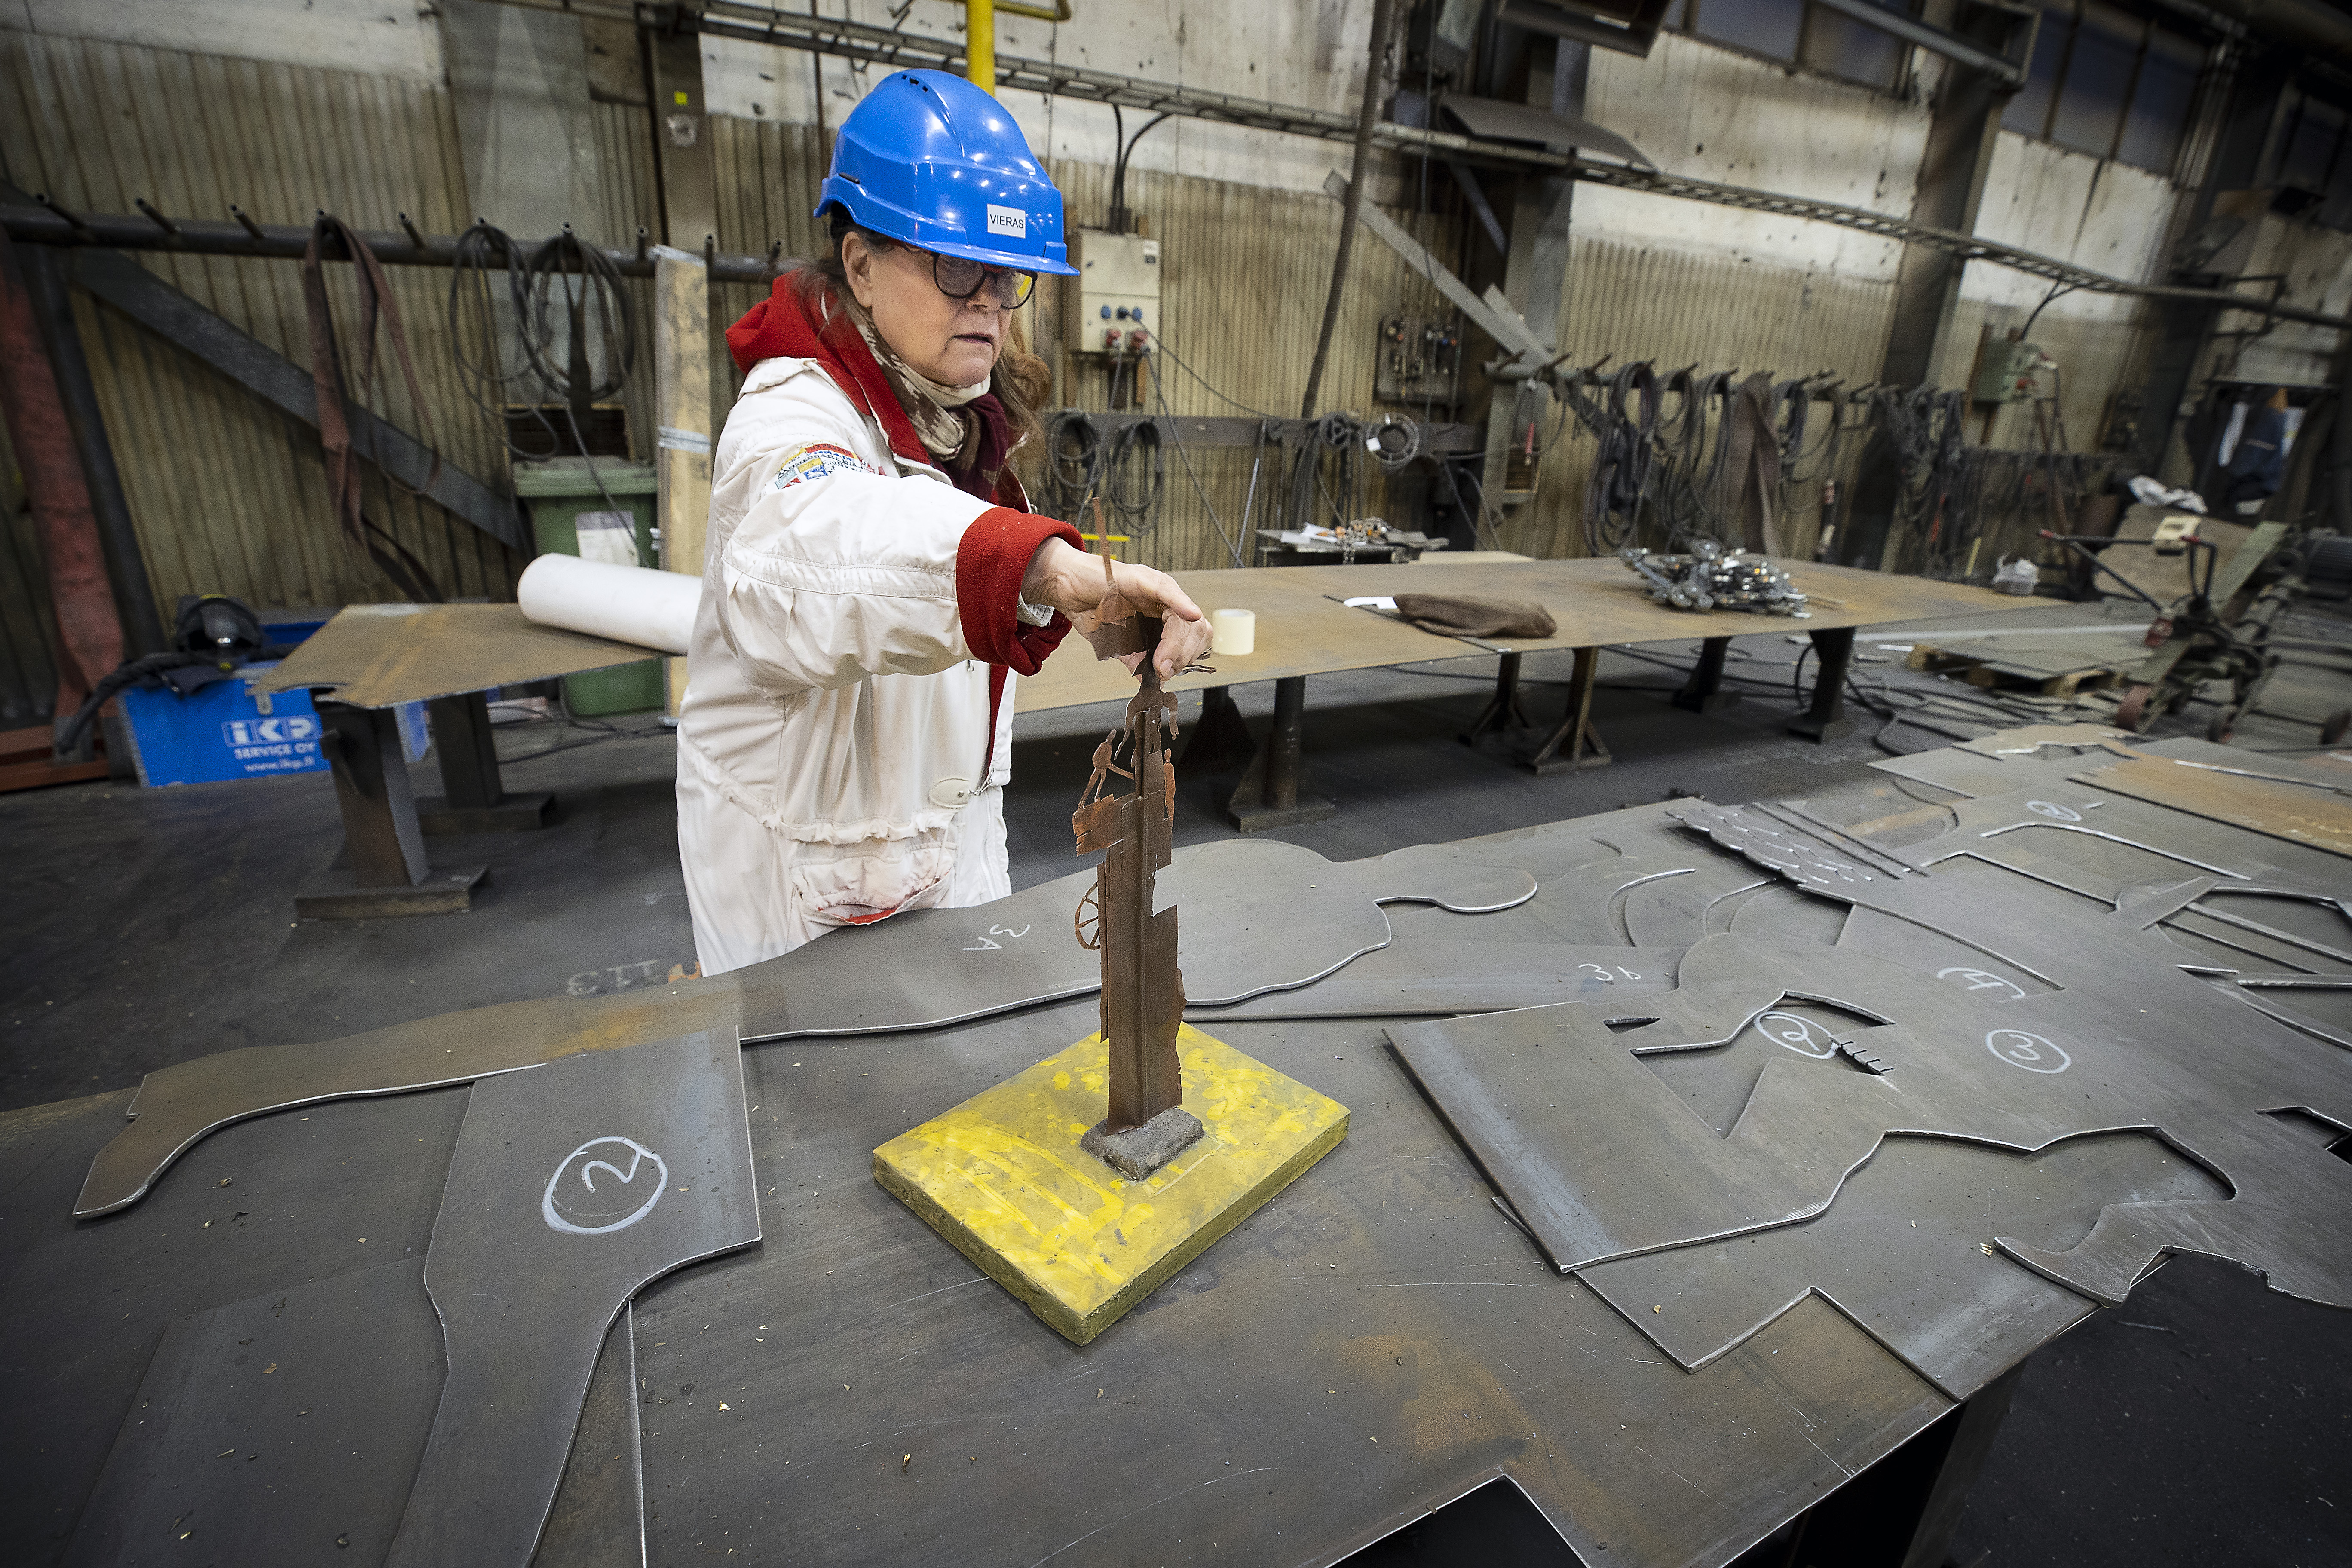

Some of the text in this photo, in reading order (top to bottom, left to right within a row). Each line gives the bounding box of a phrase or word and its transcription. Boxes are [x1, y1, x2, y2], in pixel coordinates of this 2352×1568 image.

[990, 214, 1023, 228] VIERAS
[234, 742, 315, 760] SERVICE OY
[244, 756, 316, 772] www.ikp.fi
